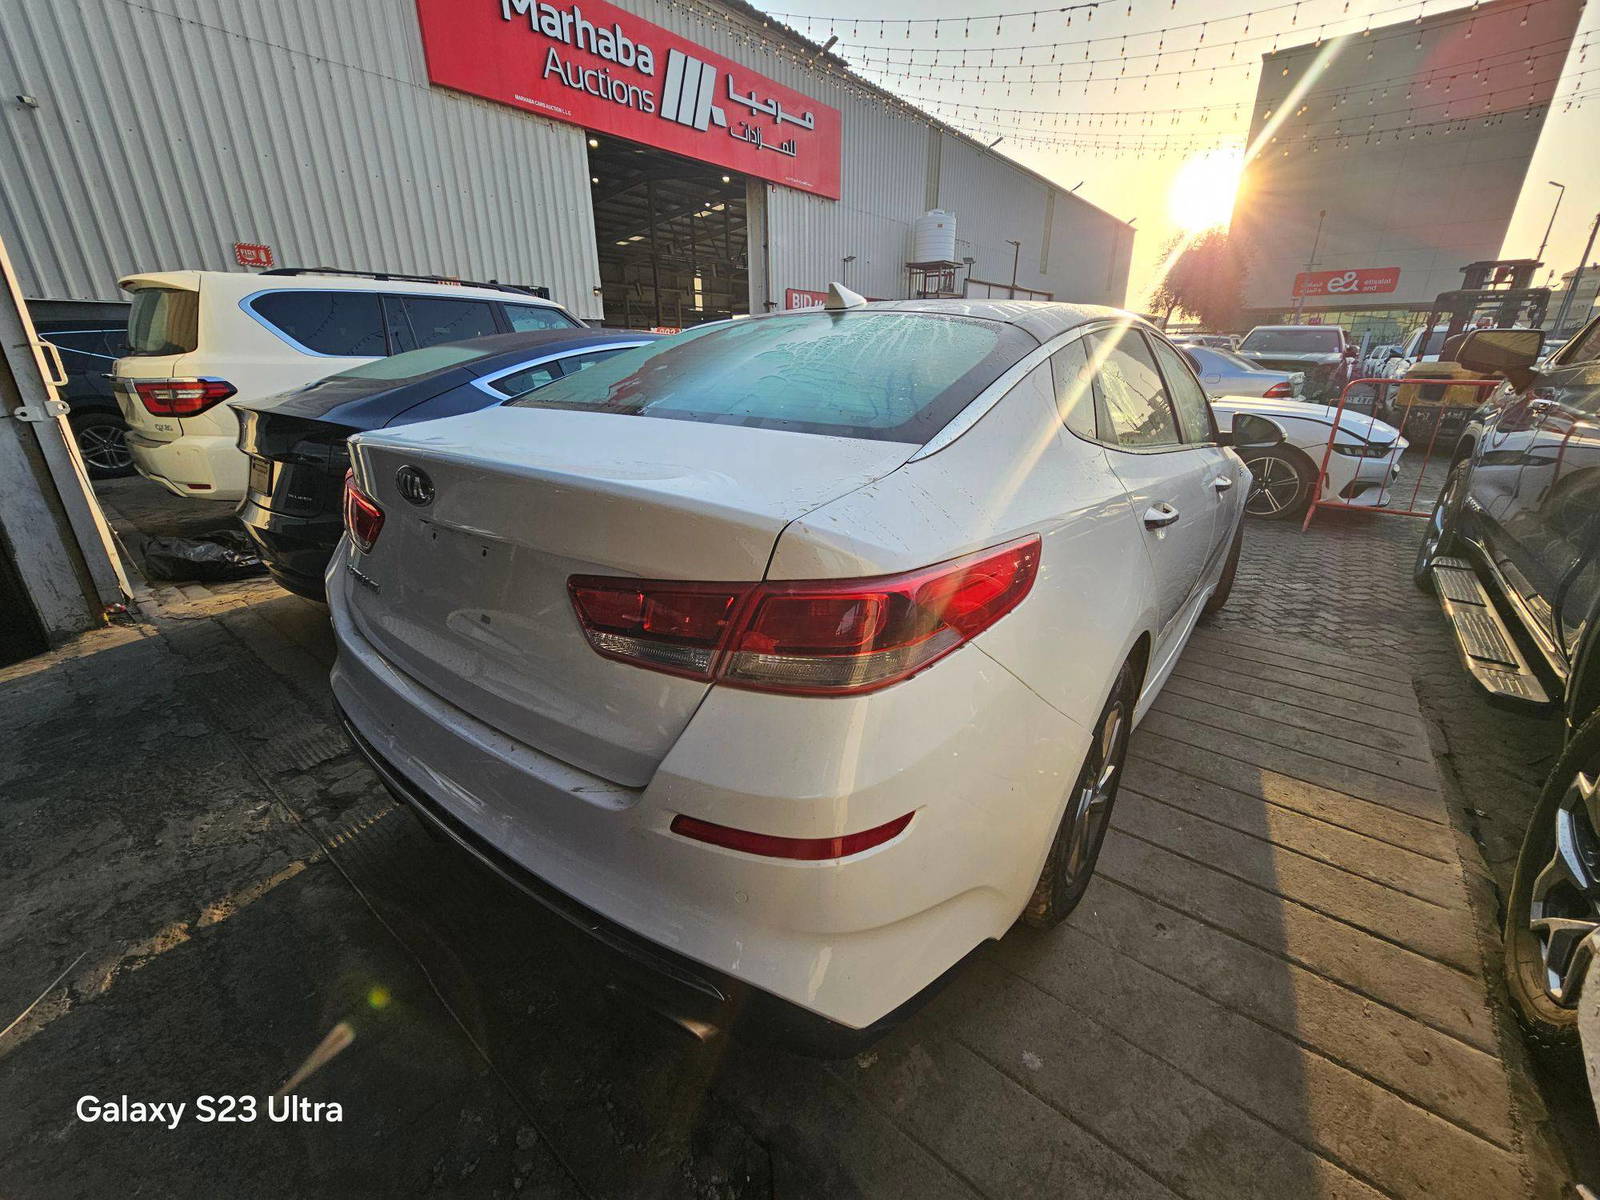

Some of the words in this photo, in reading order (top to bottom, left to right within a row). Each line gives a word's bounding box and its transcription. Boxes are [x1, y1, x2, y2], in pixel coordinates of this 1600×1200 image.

[502, 0, 655, 76] Marhaba
[543, 47, 656, 113] Auctions
[728, 73, 815, 130] مرحبا
[792, 293, 812, 308] BID
